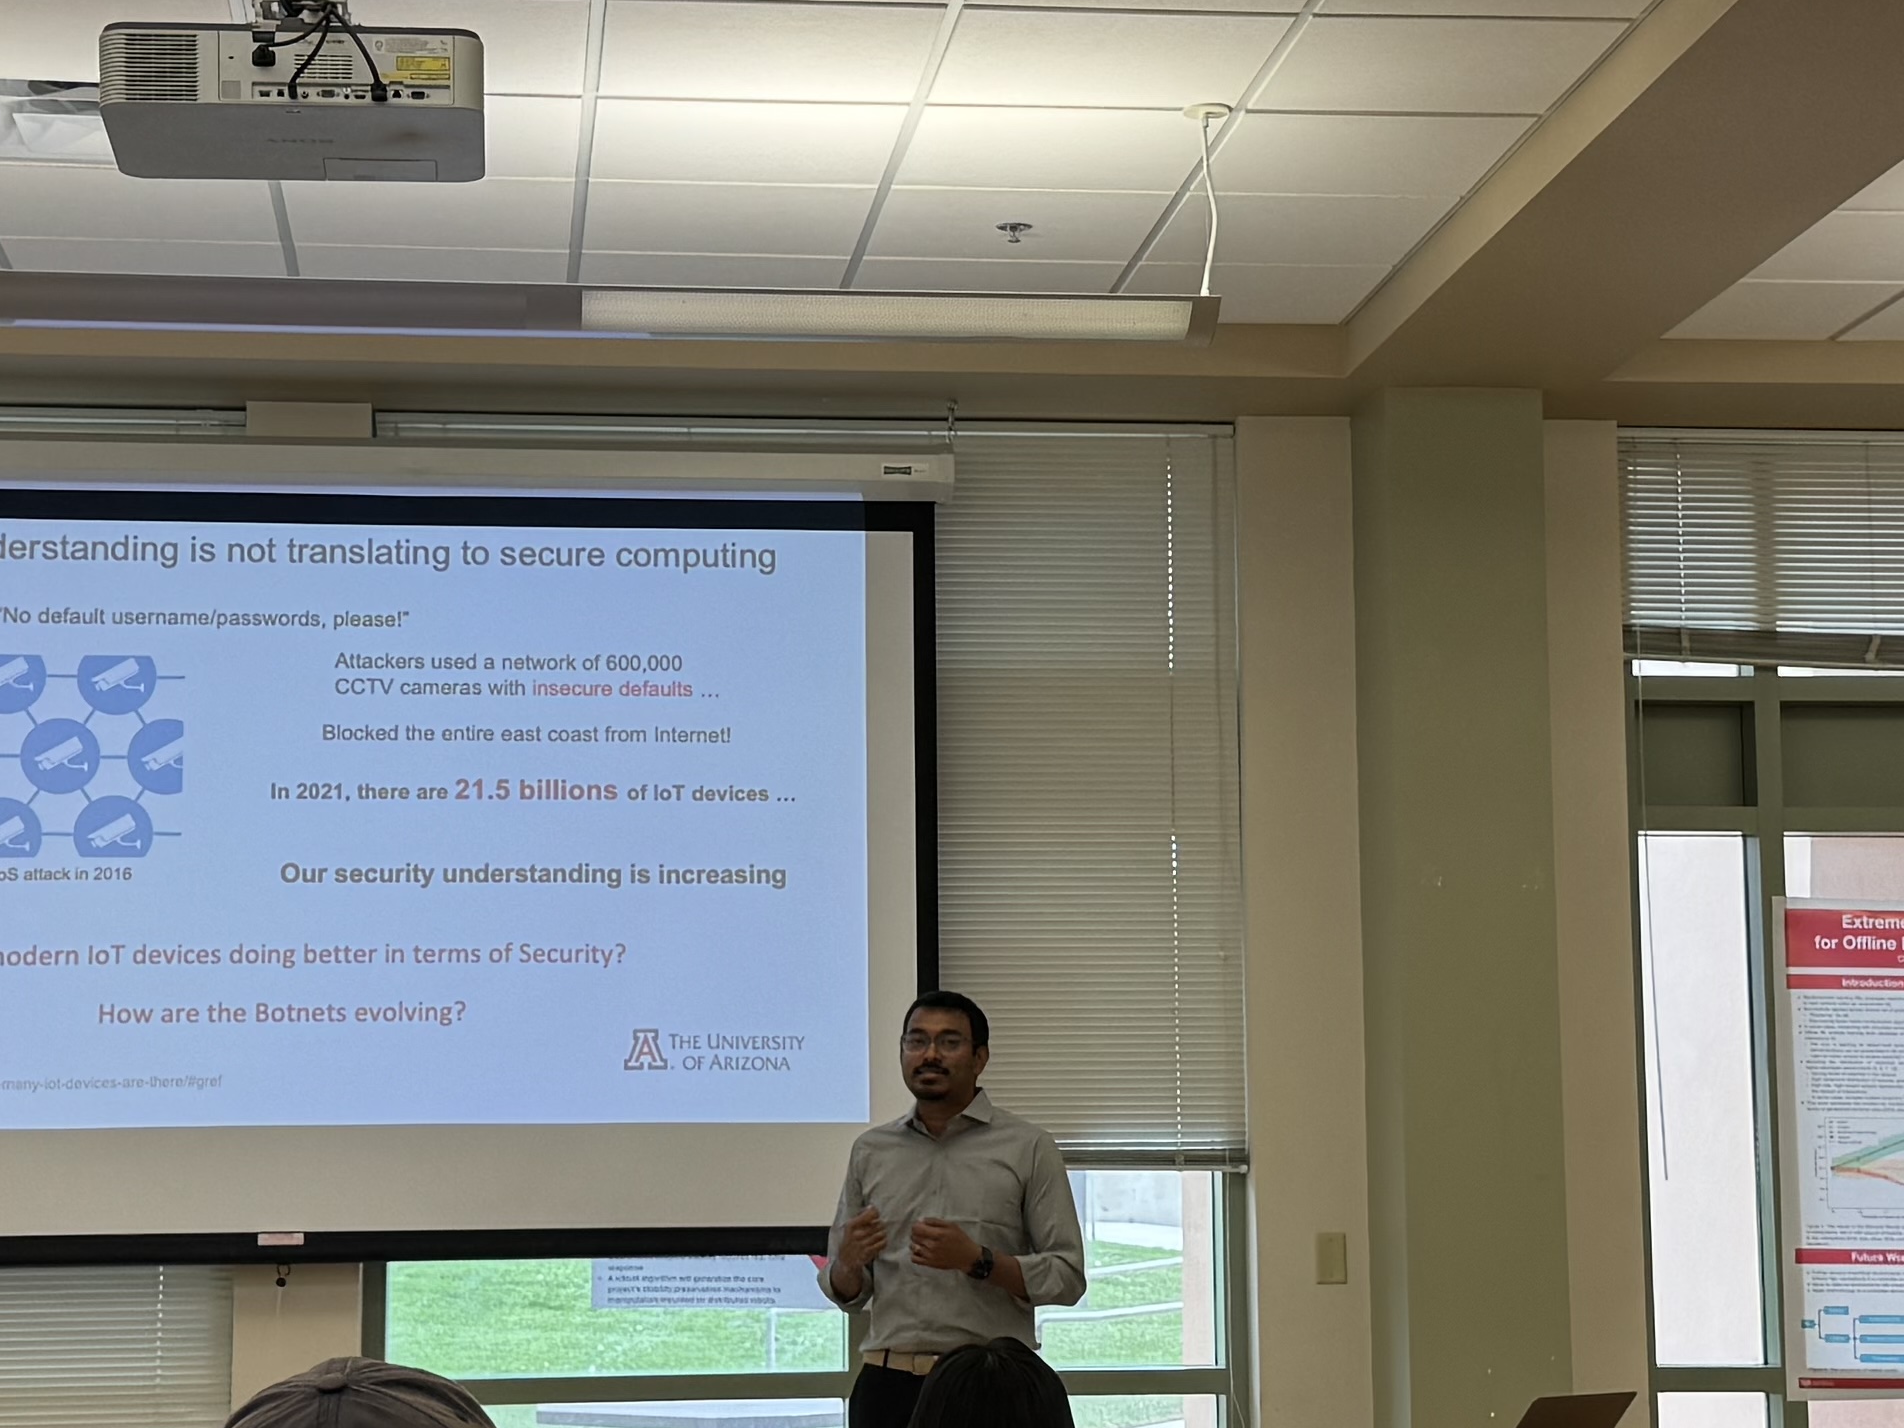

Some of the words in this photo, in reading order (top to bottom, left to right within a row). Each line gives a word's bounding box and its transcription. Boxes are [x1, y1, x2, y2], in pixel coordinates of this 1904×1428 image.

[190, 535, 216, 563] is
[227, 537, 277, 564] not
[286, 537, 451, 573] translating
[461, 540, 490, 566] to
[499, 546, 606, 567] secure
[615, 541, 776, 576] computing
[37, 606, 106, 626] default
[111, 608, 327, 630] username/passwords,
[334, 651, 426, 670] Attackers
[430, 652, 477, 671] used
[483, 656, 496, 671] a
[501, 653, 577, 671] network
[581, 653, 602, 672] of
[605, 654, 683, 674] 600,000
[334, 677, 395, 696] CCTV
[399, 682, 483, 696] cameras
[487, 679, 526, 697] with
[532, 679, 613, 697] insecure
[618, 679, 694, 698] defaults
[322, 723, 399, 742] Blocked
[405, 724, 436, 742] the
[441, 724, 495, 742] entire
[500, 725, 542, 743] east
[547, 726, 599, 743] coast
[604, 725, 647, 743] from
[654, 725, 731, 744] Internet!
[270, 782, 290, 800] In
[295, 782, 351, 803] 2021,
[356, 782, 411, 800] there
[416, 786, 449, 800] are
[454, 778, 511, 801] 21.5
[519, 778, 618, 801] billions
[626, 783, 649, 801] of
[653, 783, 686, 802] IoT
[691, 784, 770, 802] devices
[23, 867, 71, 882] attack
[74, 867, 89, 881] in
[93, 866, 133, 881] 2016
[280, 862, 329, 884] Our
[334, 862, 435, 889] security
[442, 862, 622, 890] understanding
[630, 862, 651, 885] is
[658, 863, 787, 890] increasing
[1814, 935, 1838, 950] for
[1842, 935, 1897, 951] Offline
[87, 944, 127, 966] IoT
[132, 943, 222, 965] devices
[229, 942, 296, 970] doing
[303, 942, 378, 965] better
[384, 943, 405, 964] in
[412, 945, 481, 964] terms
[488, 941, 514, 964] of
[518, 942, 627, 969] Security?
[1841, 978, 1904, 989] Introduction
[98, 1003, 154, 1025] How
[160, 1007, 200, 1024] are
[206, 1001, 247, 1024] the
[255, 1002, 347, 1023] Botnets
[354, 1000, 467, 1027] evolving?
[668, 1033, 702, 1050] THE
[706, 1032, 806, 1051] UNIVERSITY
[681, 1055, 706, 1071] OF
[708, 1053, 791, 1072] ARIZONA
[1851, 1252, 1884, 1262] Future
